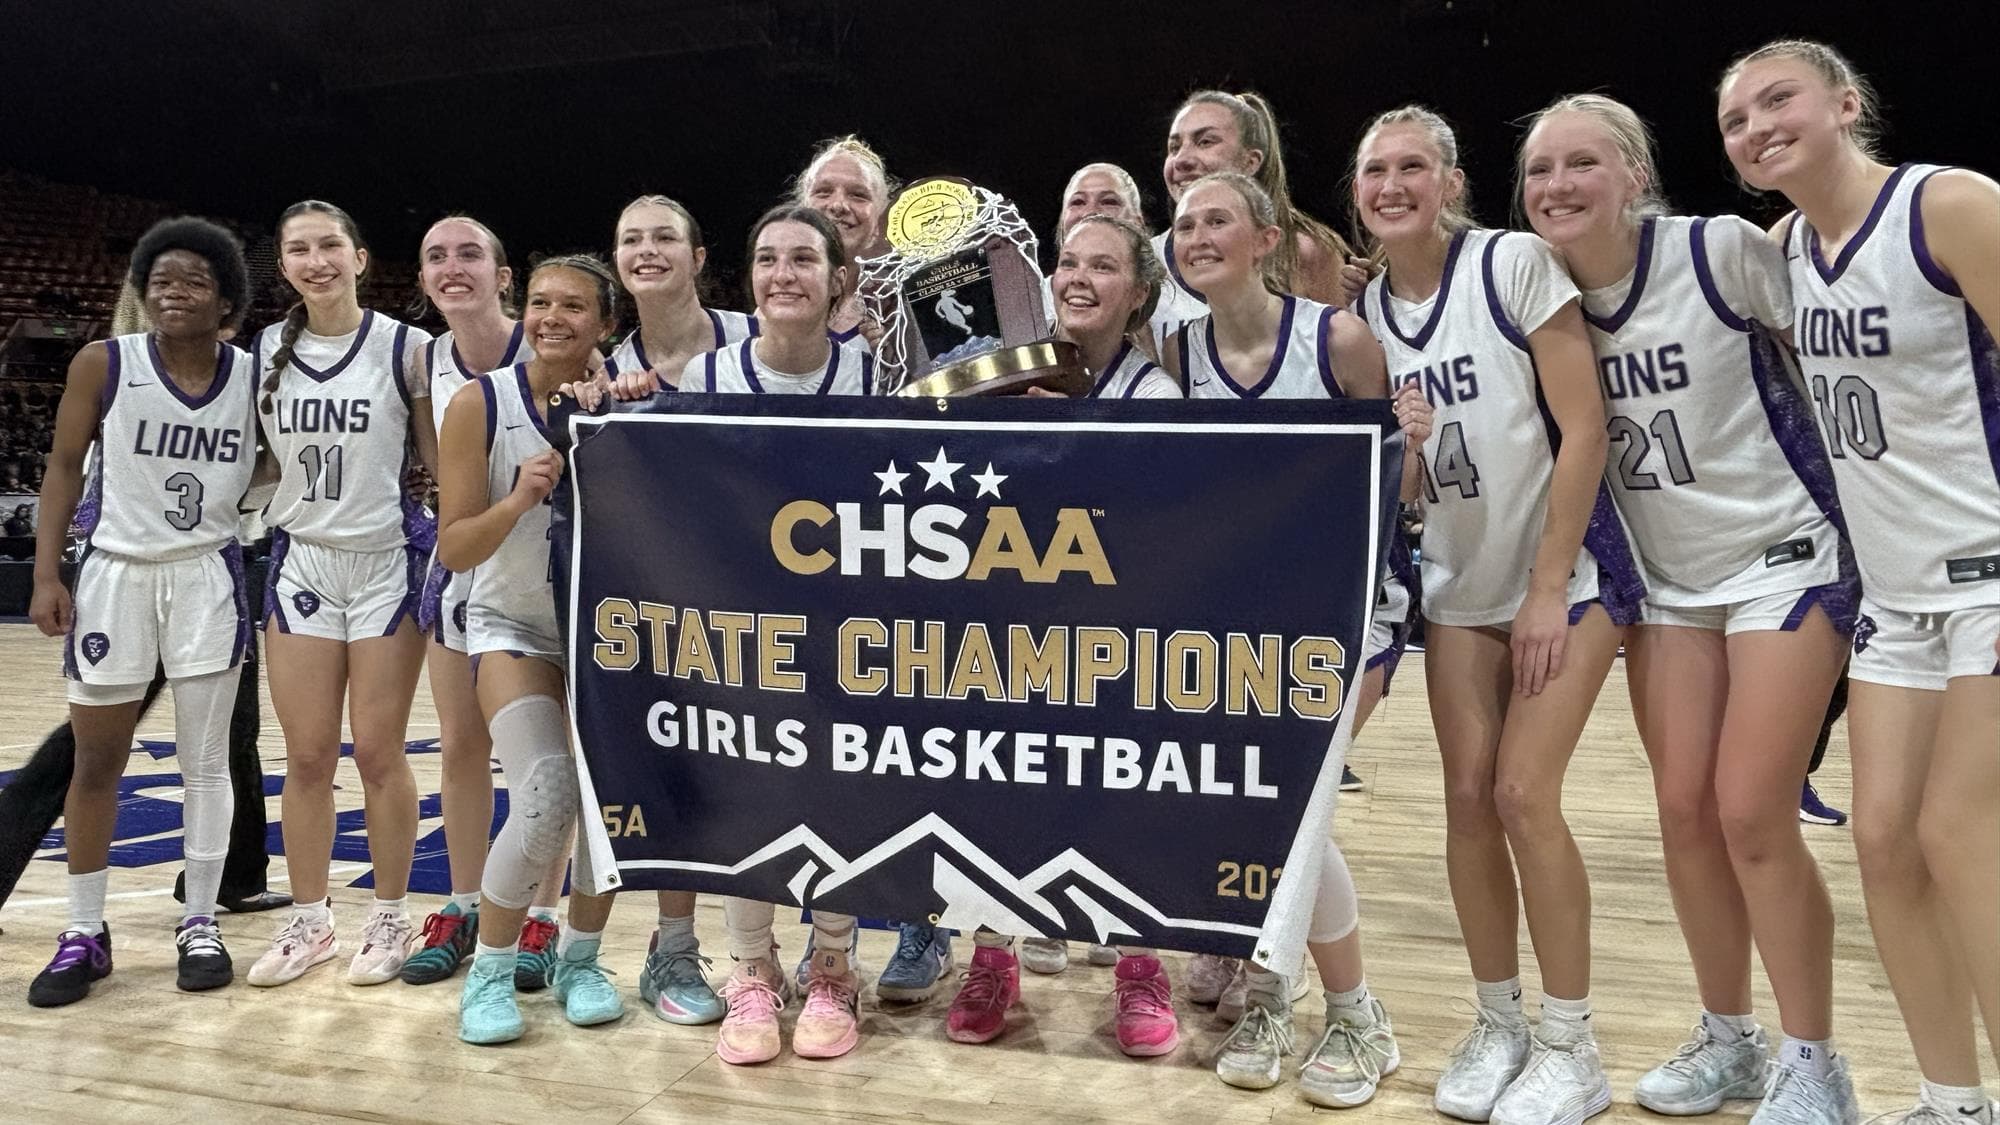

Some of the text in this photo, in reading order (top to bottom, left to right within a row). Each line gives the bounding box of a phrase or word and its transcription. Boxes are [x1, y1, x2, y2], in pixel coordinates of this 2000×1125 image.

[915, 262, 979, 287] BASKETBALL
[1800, 306, 1890, 357] IONS
[1600, 343, 1690, 399] ONS
[133, 419, 241, 463] LIONS
[277, 398, 371, 434] LIONS
[1813, 375, 1888, 460] 10
[299, 445, 342, 501] 11
[1607, 409, 1696, 490] 21
[165, 472, 204, 531] 3
[770, 499, 1117, 585] CHSAA
[1986, 563, 1995, 572] S
[593, 597, 1345, 722] STATE CHAMPIONS
[647, 701, 1278, 798] GIRLS BASKETBALL
[602, 804, 648, 838] 5A
